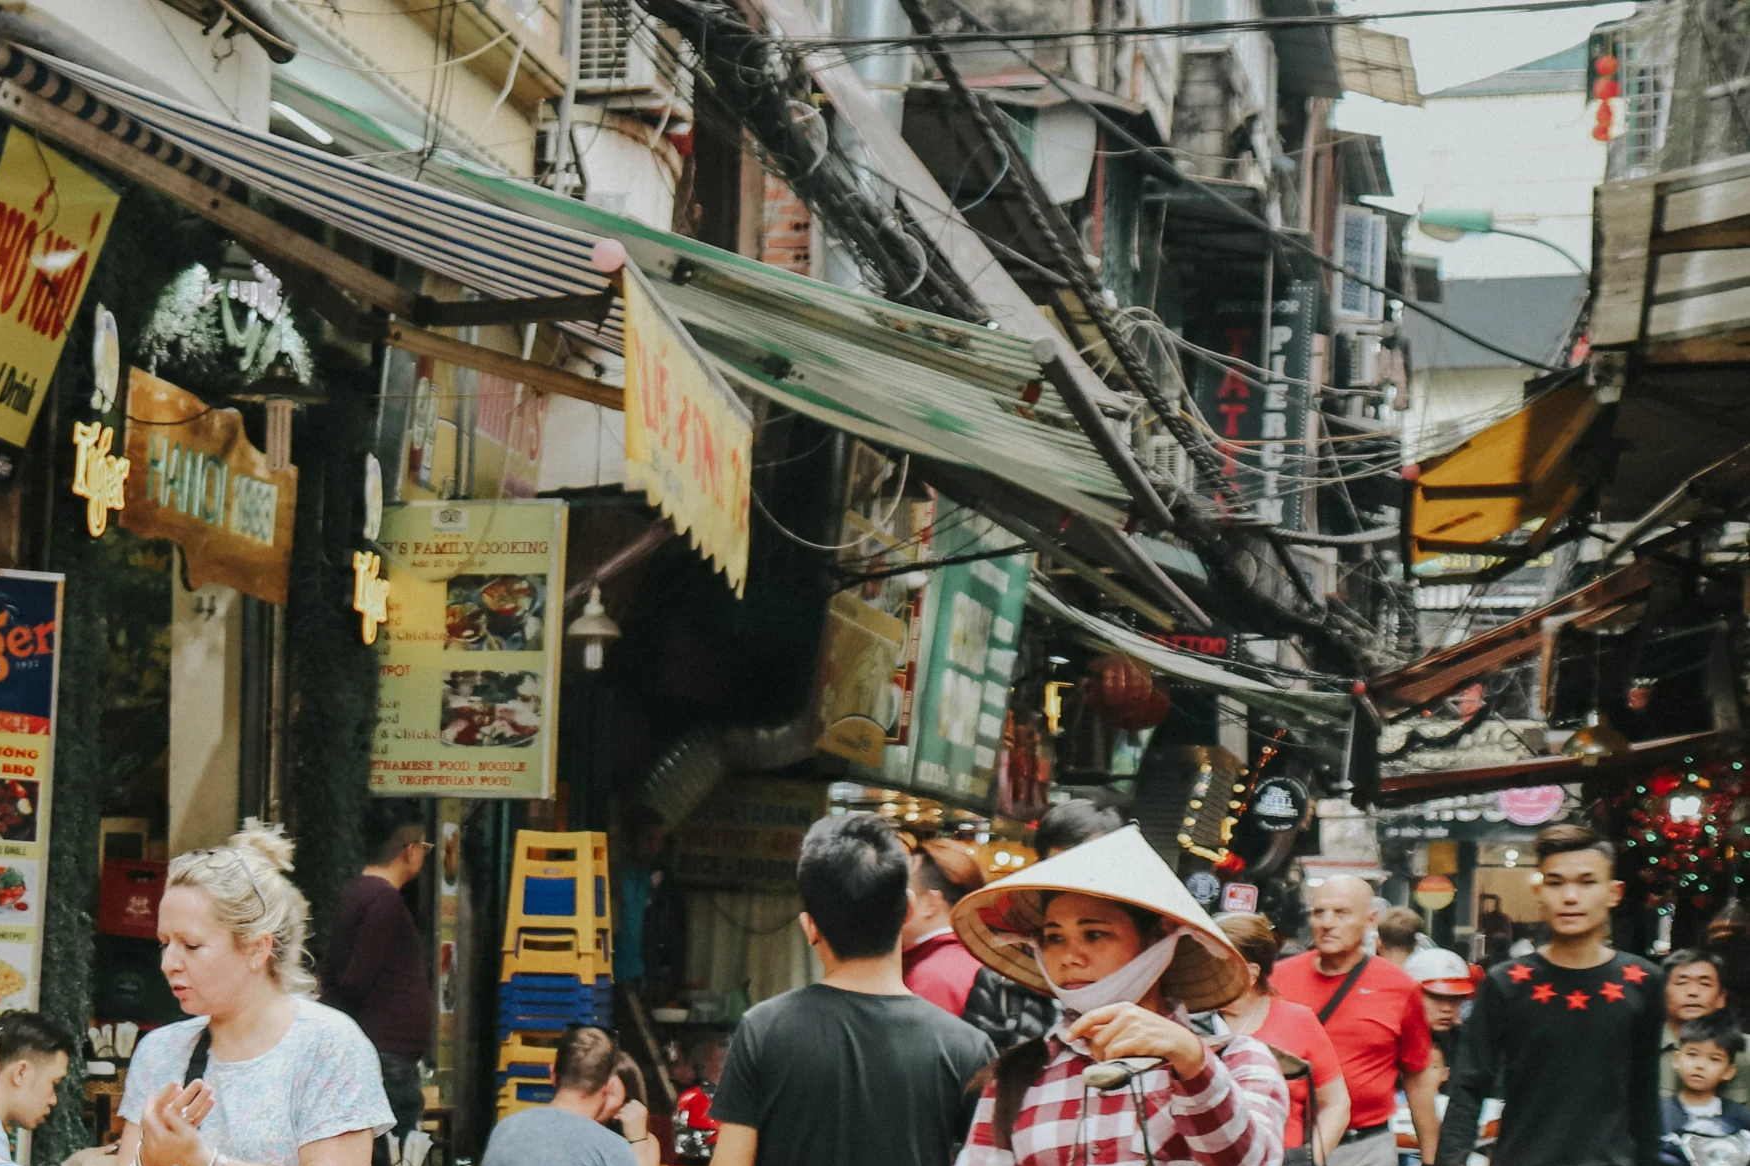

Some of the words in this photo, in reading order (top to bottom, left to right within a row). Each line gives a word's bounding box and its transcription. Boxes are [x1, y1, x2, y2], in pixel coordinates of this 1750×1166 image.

[73, 421, 131, 537] Tiger
[146, 431, 229, 527] HANOI
[413, 540, 476, 556] FAMILY
[478, 540, 549, 555] COOKING
[381, 664, 411, 677] TPOT
[2, 764, 35, 777] BBQ
[439, 761, 471, 772] FOOD
[478, 761, 527, 772] NOODLE
[480, 776, 512, 786] FOOD
